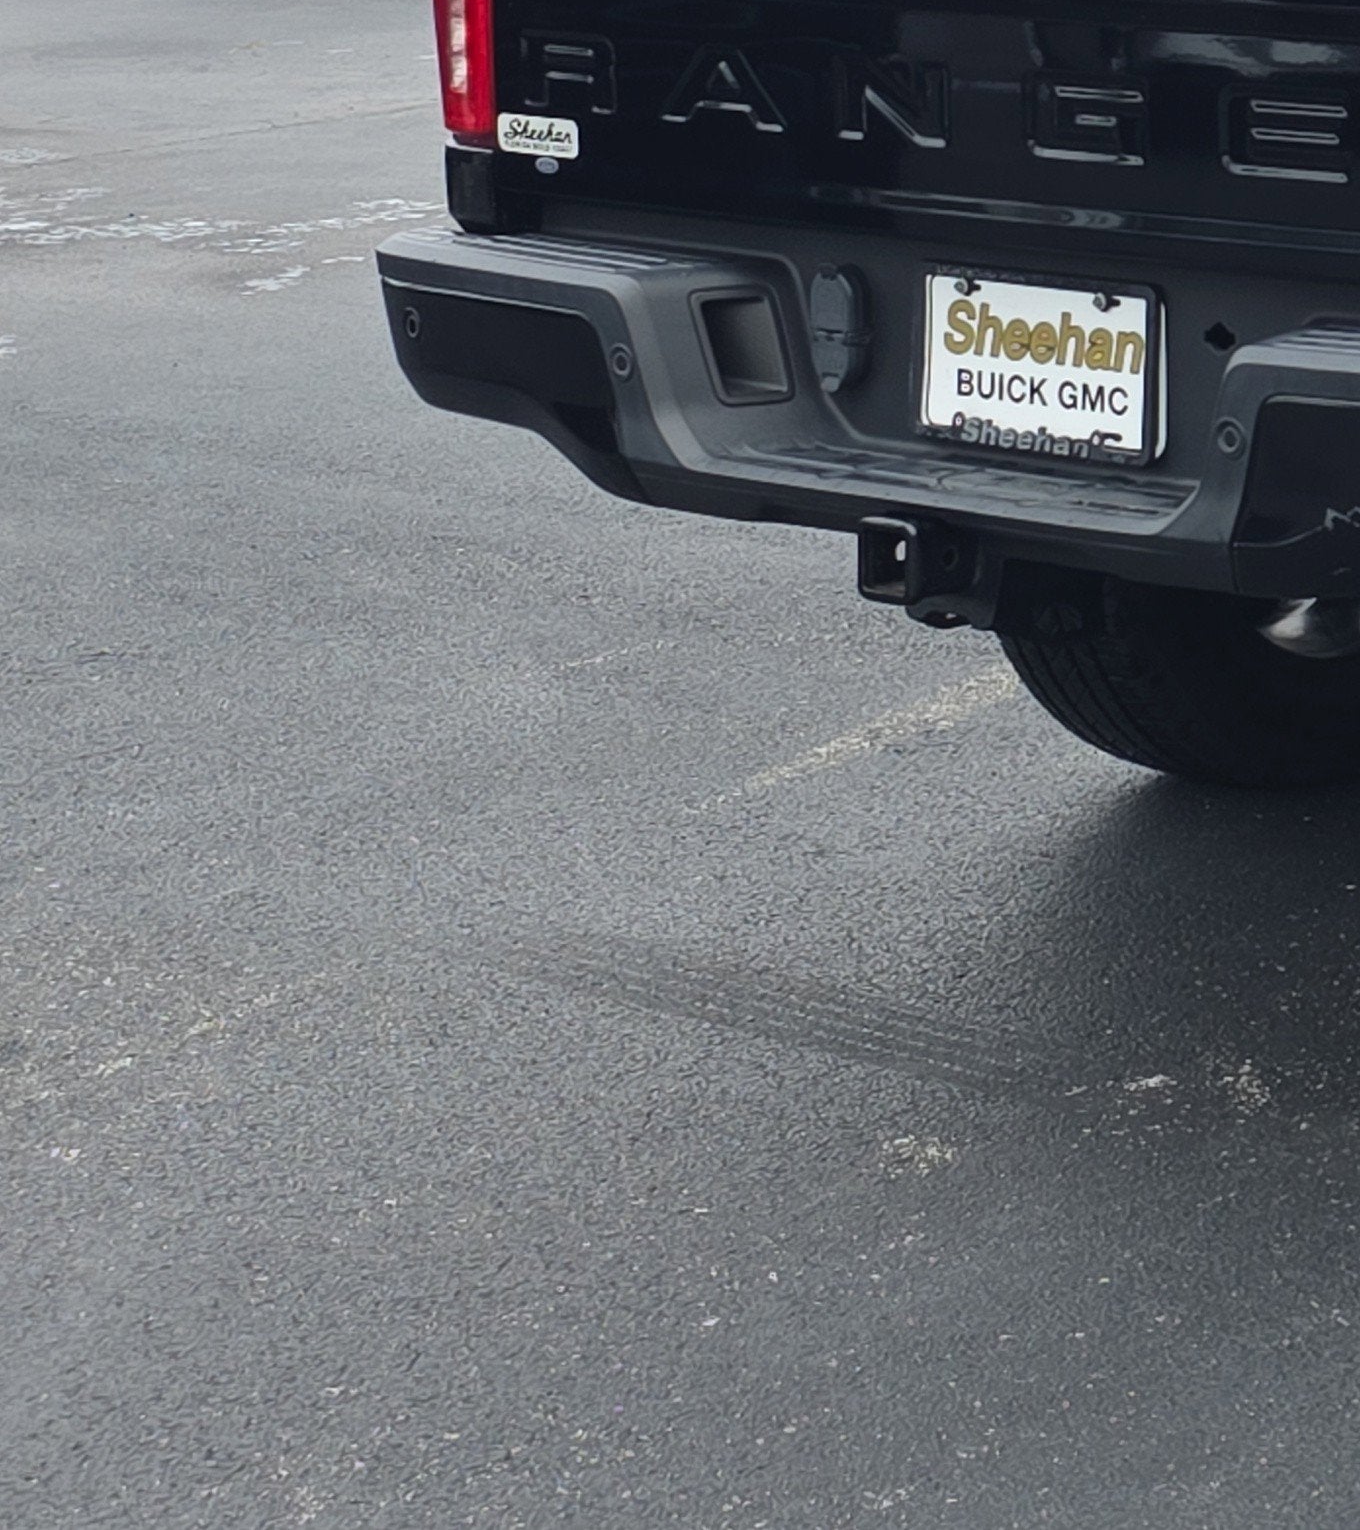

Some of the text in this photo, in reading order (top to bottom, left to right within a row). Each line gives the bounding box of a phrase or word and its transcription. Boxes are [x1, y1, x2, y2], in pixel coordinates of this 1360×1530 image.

[503, 117, 573, 145] Sheehan
[944, 299, 1145, 375] Sheehan
[957, 368, 1128, 415] BUICK GMC
[961, 416, 1089, 459] Sheehan
